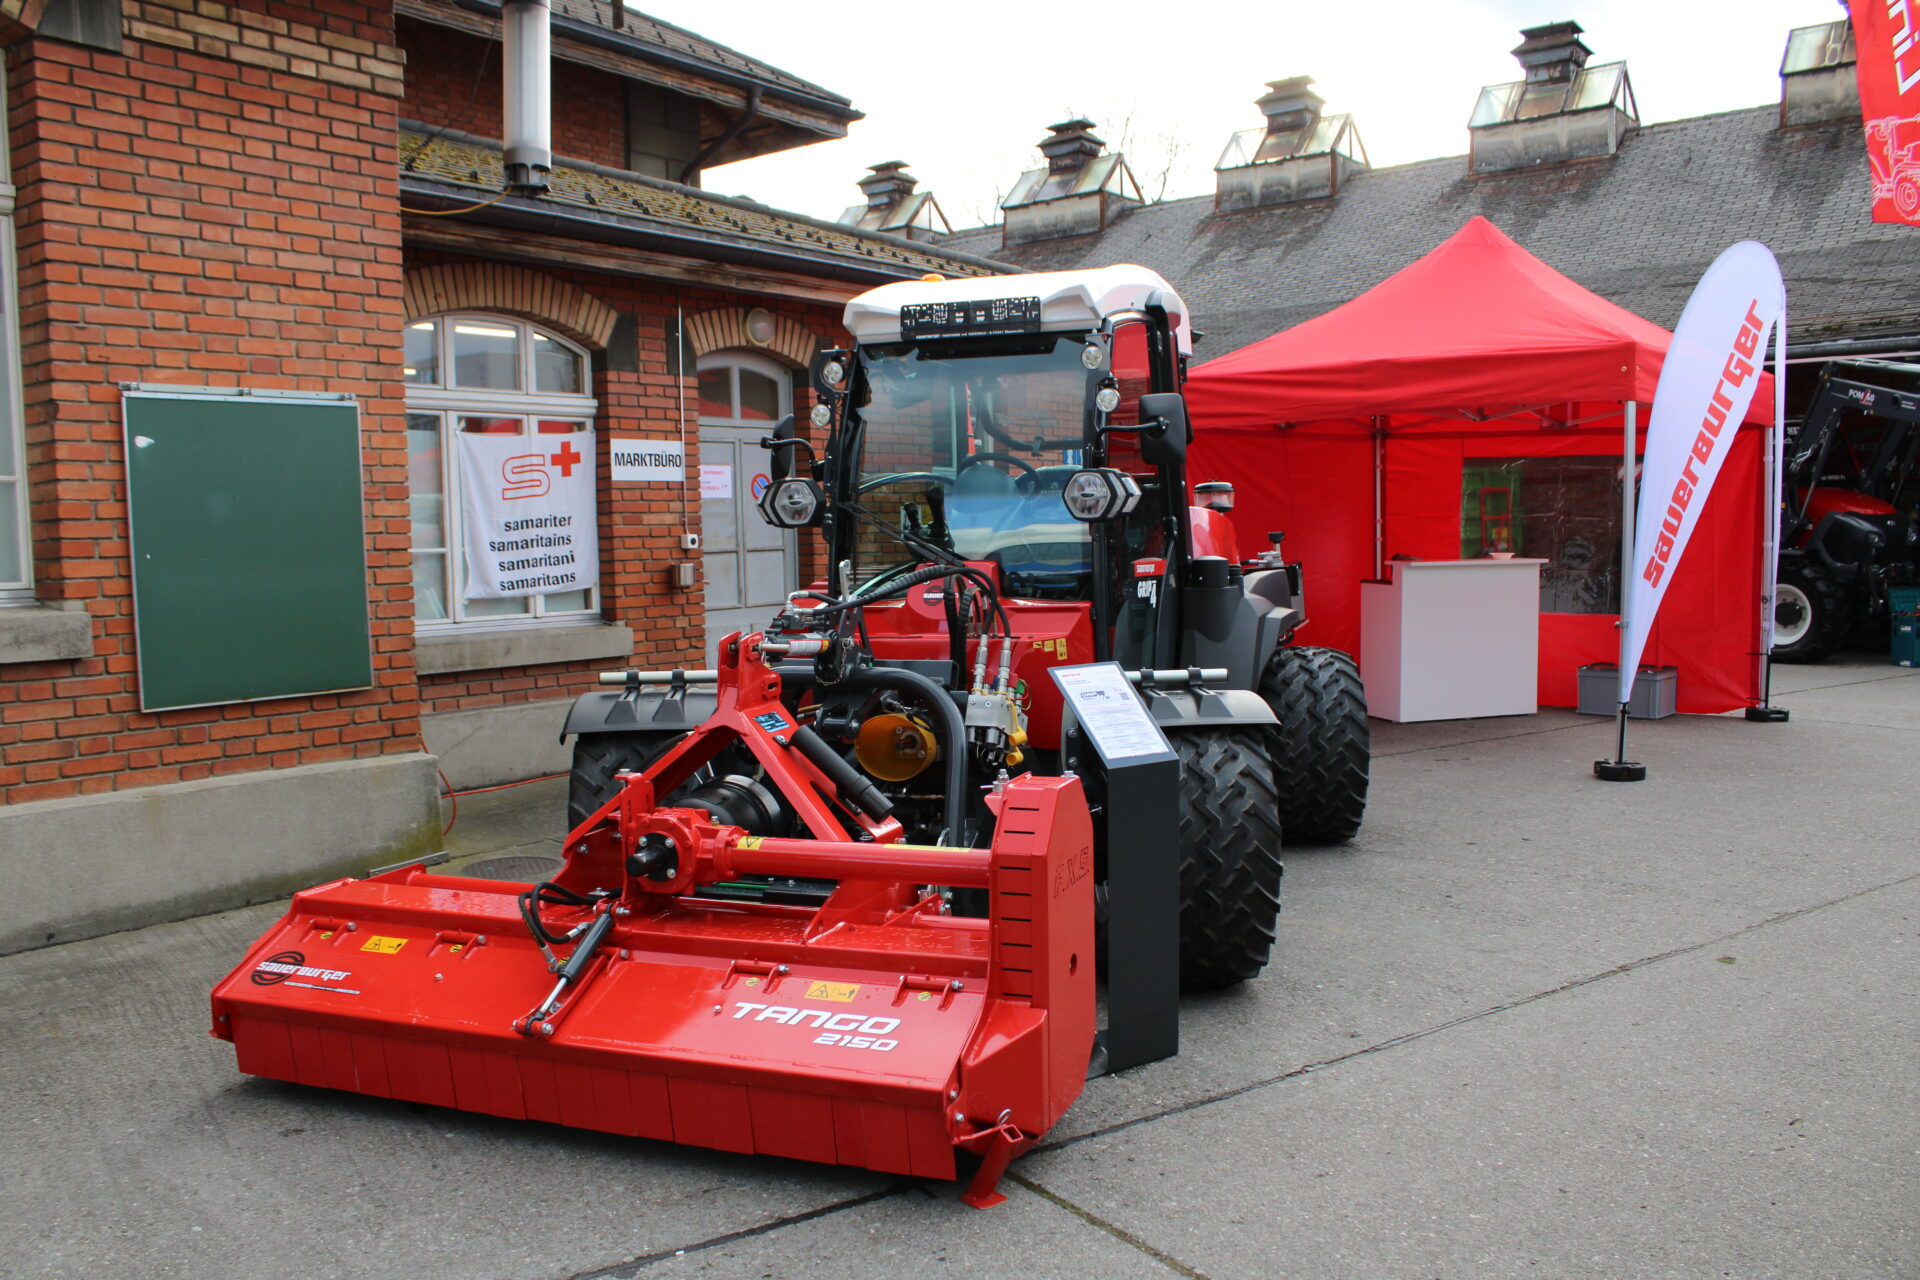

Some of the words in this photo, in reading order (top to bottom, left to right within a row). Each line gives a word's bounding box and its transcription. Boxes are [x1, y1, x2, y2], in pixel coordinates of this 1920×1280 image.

[614, 451, 682, 468] MARKTBÜRO
[504, 514, 571, 531] samariter
[489, 533, 572, 552] samaritains
[498, 550, 575, 572] samaritani
[499, 573, 577, 592] samaritans
[732, 1002, 902, 1034] TANGO
[812, 1033, 899, 1052] 2150
